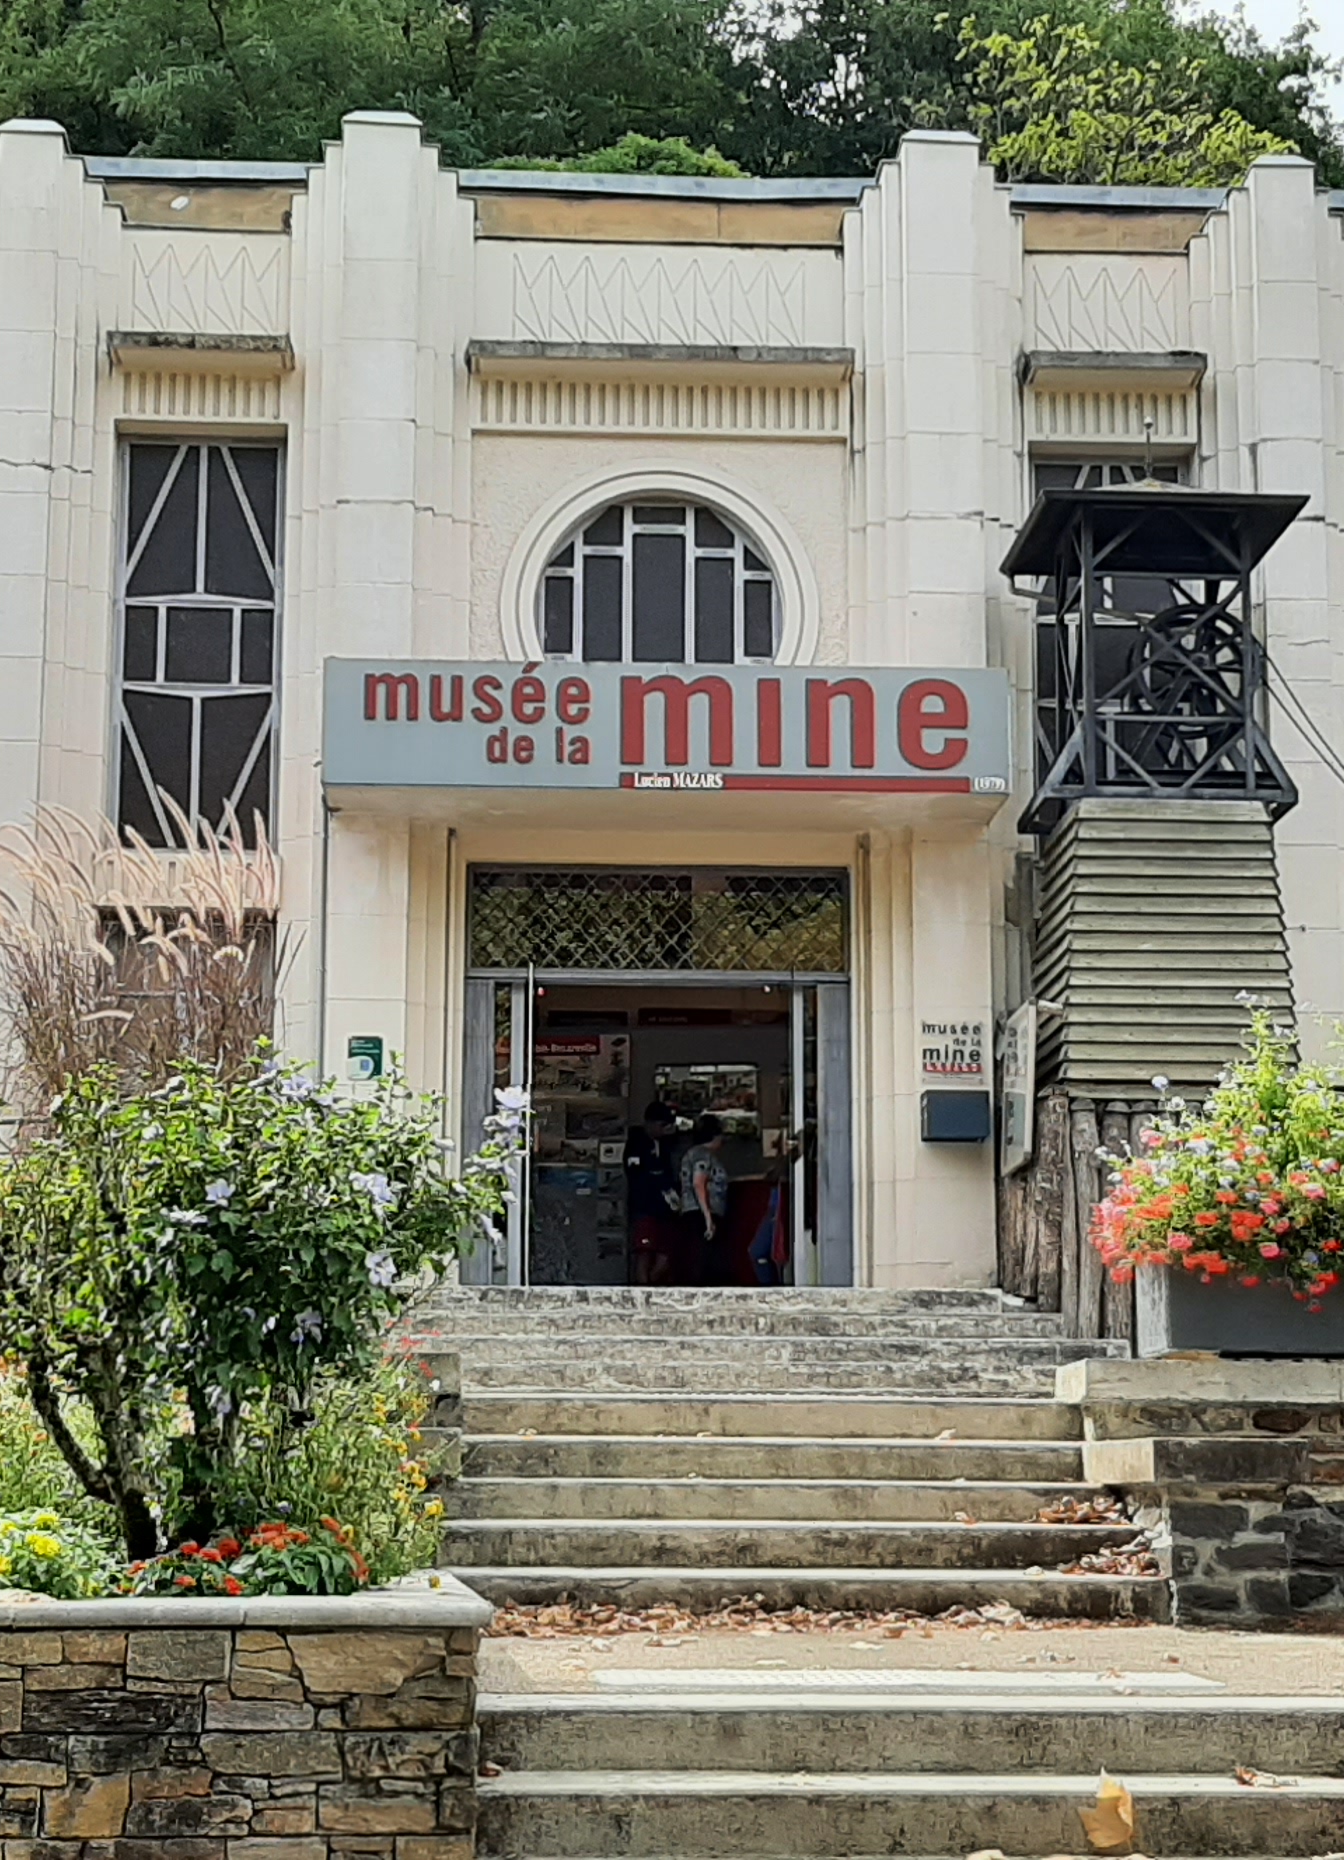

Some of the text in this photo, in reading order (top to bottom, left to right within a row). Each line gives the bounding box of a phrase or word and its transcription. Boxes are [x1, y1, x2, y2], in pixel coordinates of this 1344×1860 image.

[363, 662, 592, 725] musée
[619, 674, 971, 771] mine
[485, 727, 592, 766] de la
[634, 772, 723, 788] Lucien MAZARS
[922, 1021, 982, 1035] musée
[922, 1044, 981, 1062] mine
